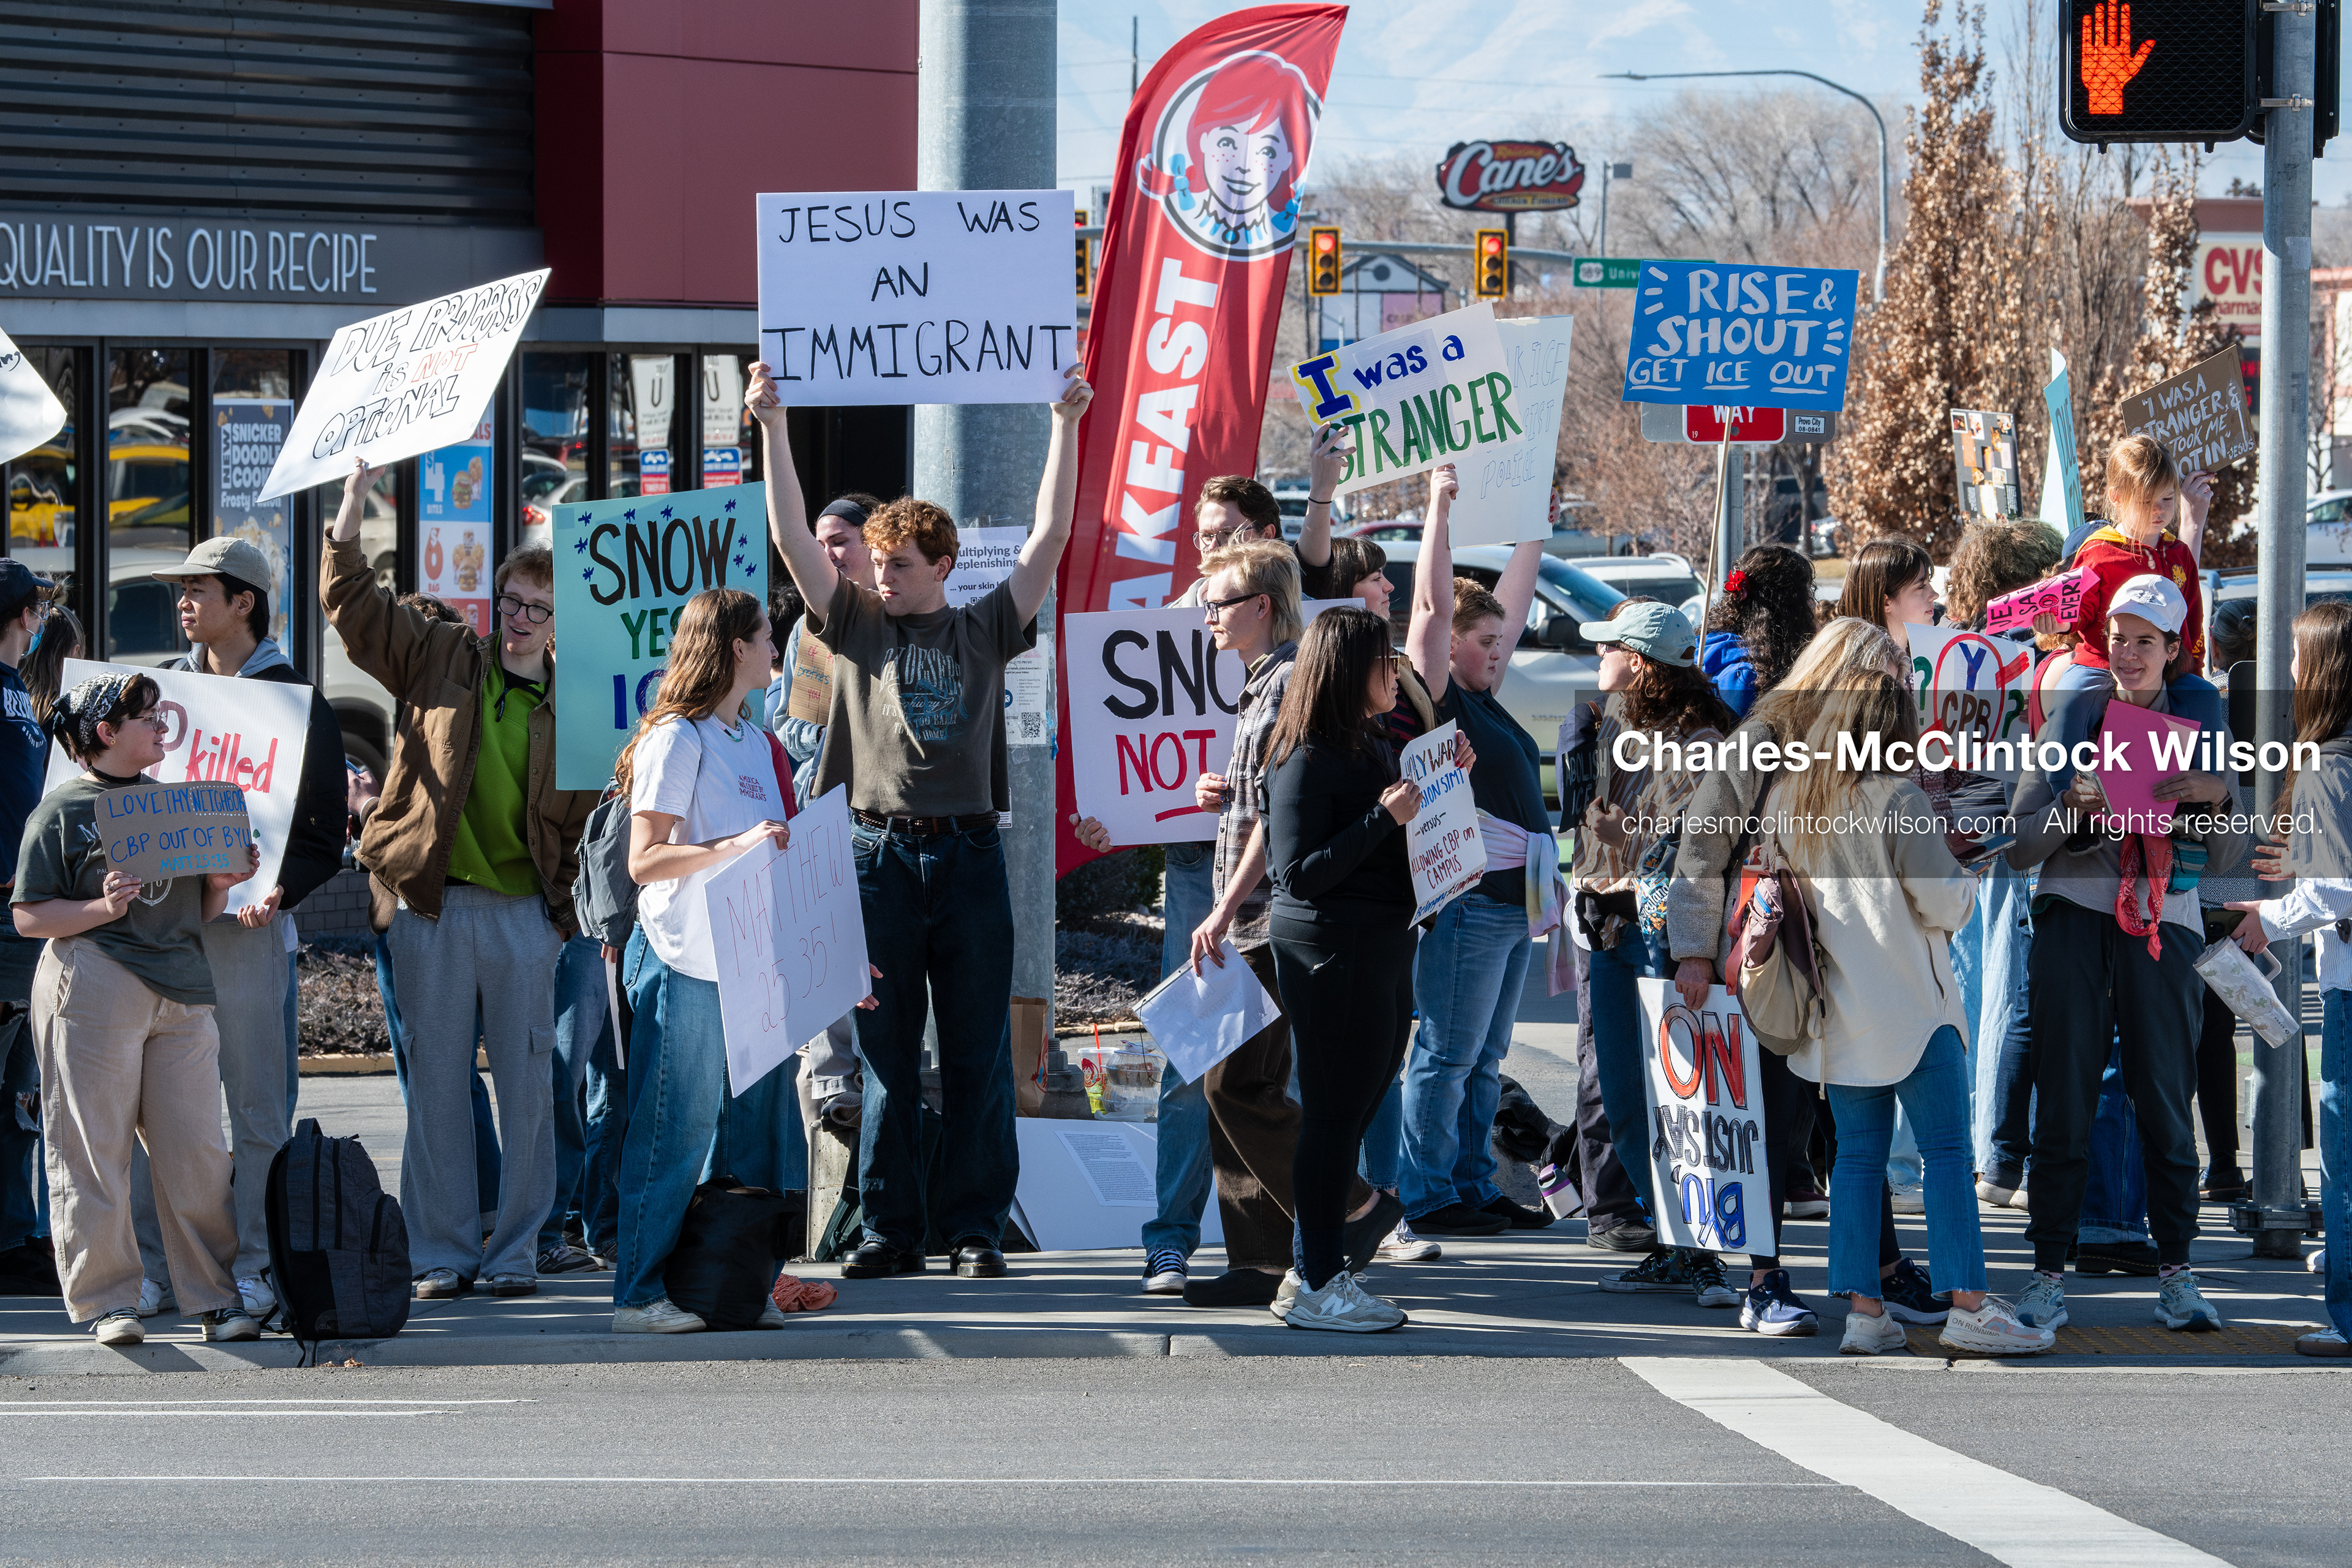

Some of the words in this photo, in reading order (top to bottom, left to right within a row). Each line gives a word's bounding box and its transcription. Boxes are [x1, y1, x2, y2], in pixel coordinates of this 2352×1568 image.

[1445, 142, 1583, 206] Cane's
[779, 199, 916, 243] JESUS
[957, 200, 1039, 234] WAS
[0, 222, 139, 289] QUALITY
[147, 227, 174, 289] IS
[187, 228, 257, 290] OUR
[268, 231, 377, 293] RECIPE
[871, 262, 928, 302] AN
[1686, 269, 1810, 314] RISE
[1813, 277, 1837, 311] &
[330, 310, 413, 377] DUE
[762, 320, 1072, 381] IMMIGRANT
[1646, 315, 1823, 356] SHOUT
[372, 362, 409, 396] is
[411, 343, 478, 383] NOT
[1297, 355, 1353, 420] I
[1352, 345, 1428, 390] was
[1442, 334, 1466, 362] a
[1629, 357, 1689, 385] GET
[1706, 360, 1752, 384] ICE
[1769, 361, 1836, 386] OUT
[2158, 380, 2194, 410] WAS
[2196, 372, 2207, 396] A
[232, 423, 282, 443] SNICKER
[312, 374, 460, 459] OPTIONAL
[1322, 371, 1523, 486] STRANGER
[1713, 405, 1756, 424] WAY
[1812, 418, 1821, 427] City
[2169, 425, 2203, 458] TOOK
[2206, 412, 2228, 441] ME
[1480, 446, 1537, 500] POLICE
[2174, 446, 2204, 483] OT
[221, 491, 251, 512] Frosty
[589, 514, 737, 605] SNOW
[959, 545, 1011, 558] ultiplying
[1013, 545, 1022, 554] &
[2060, 567, 2082, 620] EVERY
[1958, 642, 1987, 693] Y
[185, 728, 278, 794] killed
[739, 774, 760, 785] AMERICA
[1116, 729, 1216, 796] NOT
[1404, 750, 1427, 784] HOLY
[1427, 739, 1456, 773] WAR
[1565, 747, 1607, 788] ABOLISH
[107, 791, 162, 818] LOVE
[162, 788, 192, 815] THY
[192, 788, 247, 813] NEIGHBOR
[738, 780, 749, 790] WAS
[739, 787, 767, 802] IMMIGRANTS
[1571, 783, 1593, 816] ICE
[111, 833, 150, 863] CBP
[159, 827, 190, 850] OUT
[193, 826, 216, 848] OF
[223, 825, 251, 849] BYU
[160, 856, 193, 873] MATT
[195, 853, 230, 869] 25:35
[1411, 842, 1443, 878] ALLOWING
[1442, 829, 1460, 855] CBP
[1463, 826, 1475, 842] on
[1427, 854, 1462, 889] CAMPUS
[726, 820, 844, 977] MATTHEW
[1657, 1003, 1748, 1110] NO
[1652, 1104, 1701, 1167] SAY
[1703, 1110, 1759, 1175] JUST
[1952, 1317, 1965, 1327] ON
